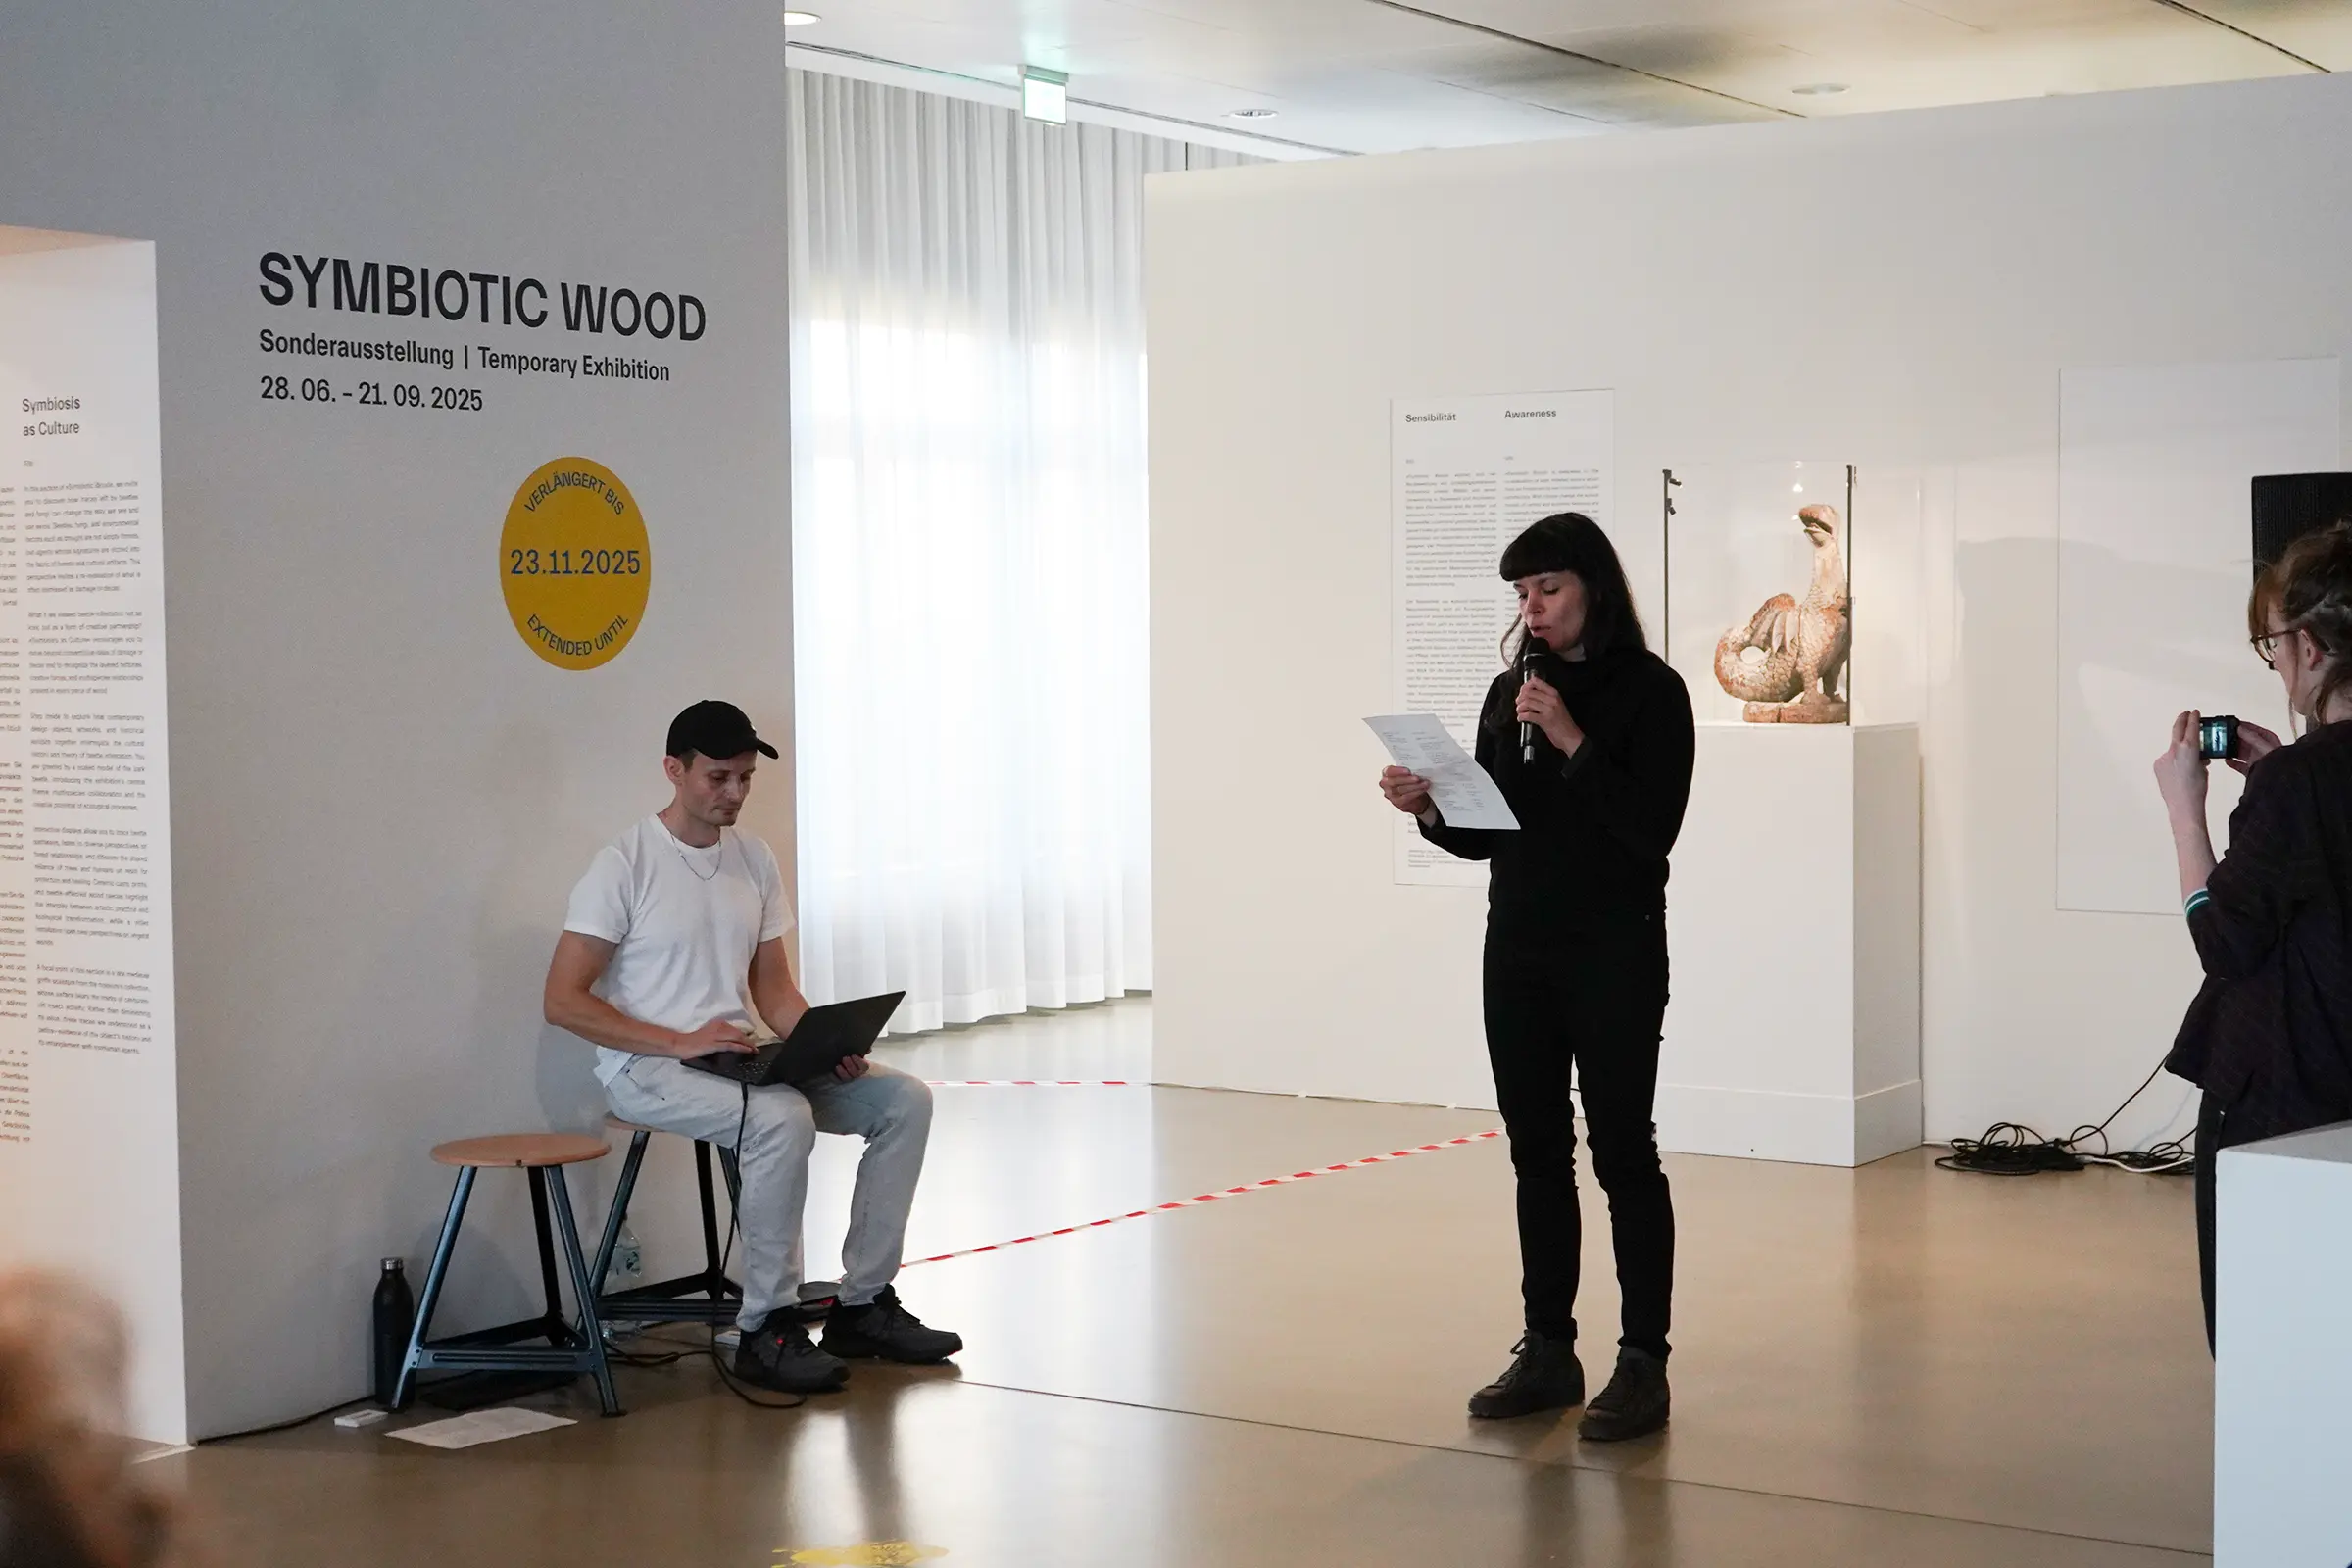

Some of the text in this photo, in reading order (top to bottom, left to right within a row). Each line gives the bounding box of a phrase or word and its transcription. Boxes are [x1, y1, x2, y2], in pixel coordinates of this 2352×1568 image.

[259, 251, 707, 342] SYMBIOTIC WOOD
[259, 328, 454, 370] Sonderausstellung
[477, 345, 578, 379] Temporary
[582, 354, 670, 381] Exhibition
[22, 396, 81, 415] Symbiosis
[431, 386, 483, 412] 2025
[1404, 412, 1457, 423] Sensibilität
[1503, 409, 1557, 419] Awareness
[23, 421, 80, 437] as Culture
[523, 470, 625, 516] VERLÄNGERT BIS
[510, 548, 642, 576] 23.11.2025
[526, 613, 629, 657] EXTENDED UNTIL
